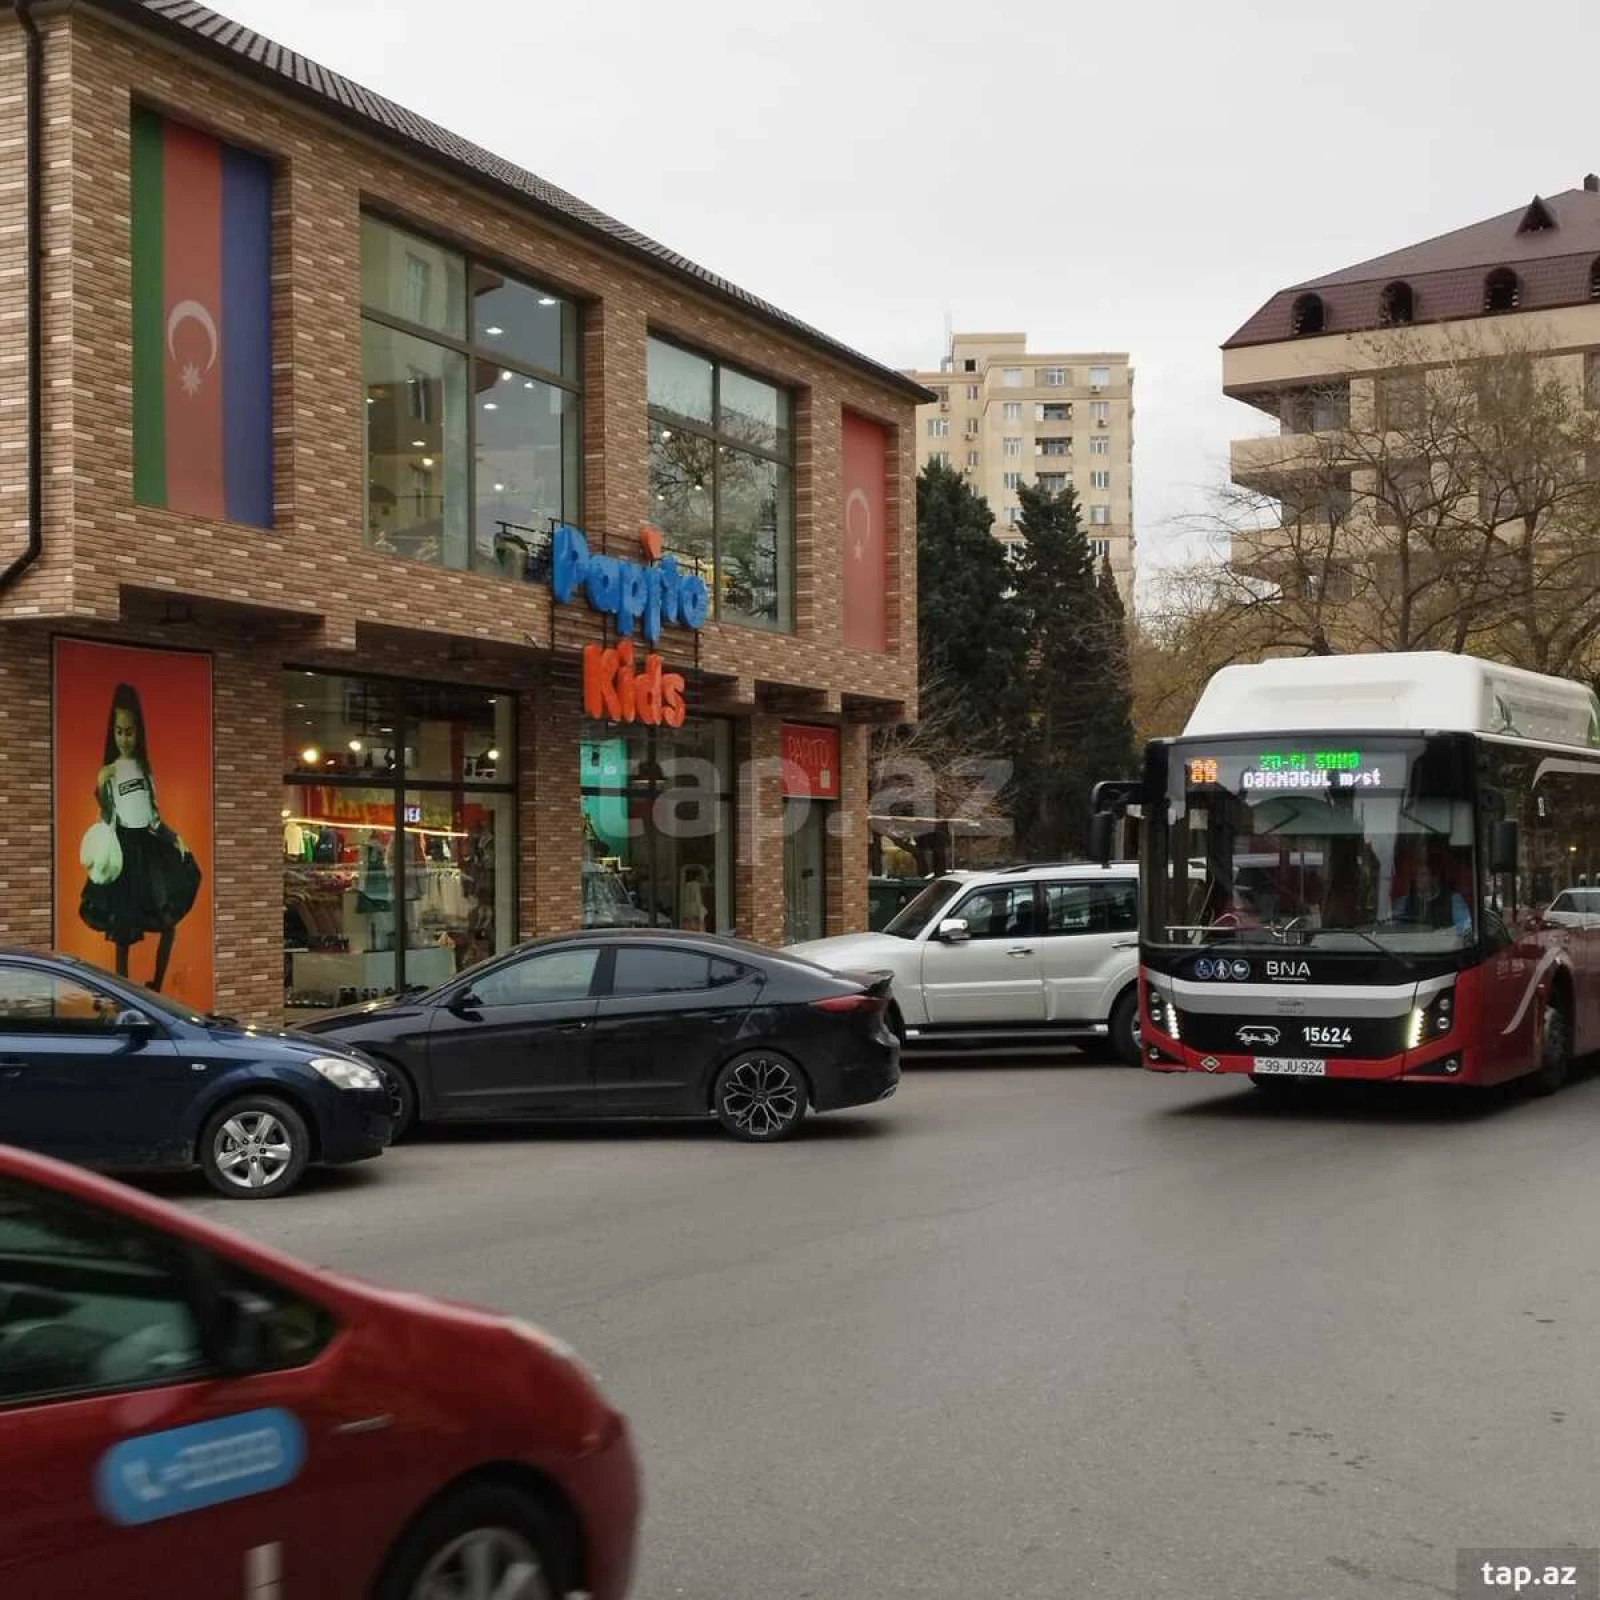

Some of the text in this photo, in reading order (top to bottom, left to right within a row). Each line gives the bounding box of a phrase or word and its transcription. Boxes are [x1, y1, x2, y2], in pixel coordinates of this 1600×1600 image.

[553, 524, 709, 641] Papito
[584, 639, 686, 728] Kids
[1266, 961, 1311, 976] BNA
[1303, 1027, 1353, 1043] 15624
